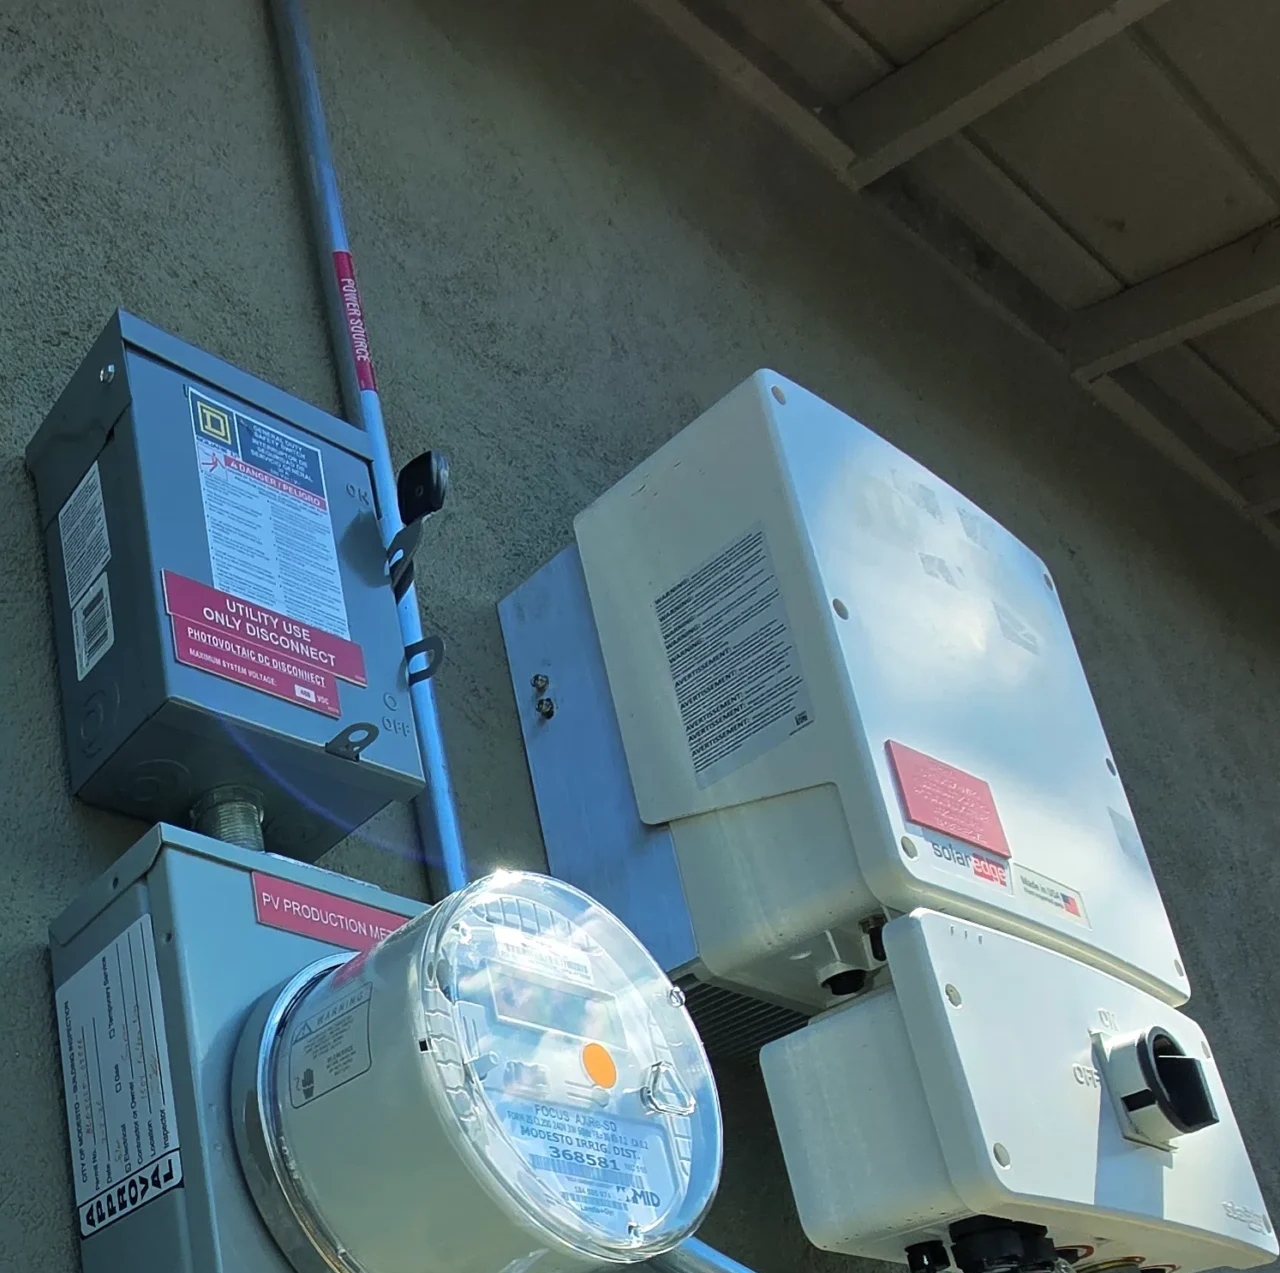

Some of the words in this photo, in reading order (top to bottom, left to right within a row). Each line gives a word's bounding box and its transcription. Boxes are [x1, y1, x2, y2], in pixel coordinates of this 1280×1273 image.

[341, 278, 361, 317] POWER
[350, 318, 371, 363] SOURCE
[239, 463, 277, 488] DANGER
[282, 483, 321, 507] PELIGRO
[203, 607, 244, 632] ONLY
[246, 624, 336, 667] DISCONNECT
[225, 598, 280, 629] UTILITY
[282, 621, 312, 643] USE
[187, 627, 257, 661] PHOTOVOLTAIC
[271, 658, 326, 688] DISCONNECT
[222, 660, 247, 677] SYSTEM
[262, 891, 280, 911] PV
[283, 898, 368, 937] PRODUCTION
[100, 956, 109, 985] Service
[104, 987, 115, 1028] Temporary
[316, 991, 364, 1026] WARNING
[69, 1053, 79, 1093] BUILDING
[1072, 1062, 1102, 1089] OFF
[127, 1081, 136, 1108] Owner
[534, 1104, 570, 1122] FOCUS
[120, 1124, 131, 1162] Electrical
[134, 1122, 143, 1165] Contractor
[146, 1120, 156, 1156] Location
[158, 1108, 170, 1148] Inspector
[520, 1125, 573, 1146] MODESTO
[548, 1145, 620, 1171] 368581
[85, 1157, 174, 1229] APPROVAL
